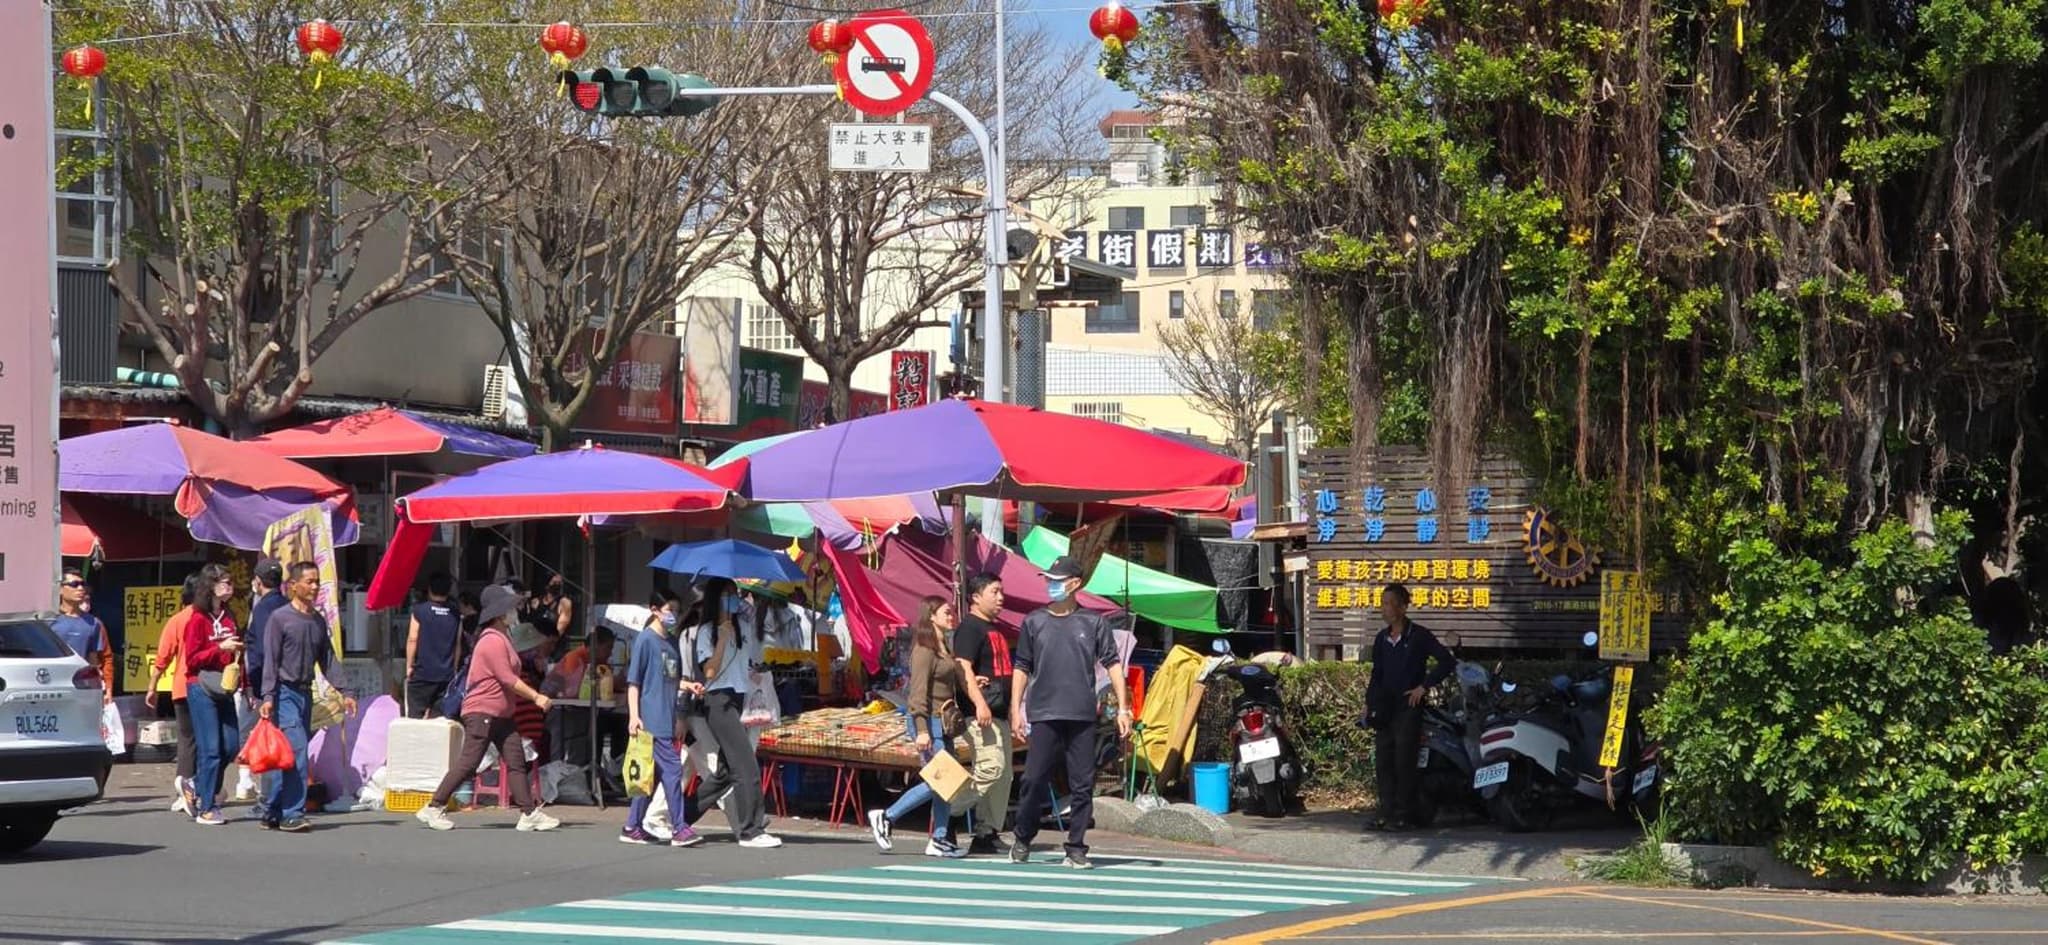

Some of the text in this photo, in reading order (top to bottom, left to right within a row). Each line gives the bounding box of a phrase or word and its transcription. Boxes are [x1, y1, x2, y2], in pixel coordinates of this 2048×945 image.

[834, 130, 927, 146] 禁止大客車
[853, 150, 906, 166] 進入
[743, 367, 781, 408] 不動產
[1316, 559, 1492, 581] 愛護孩子的學習環境
